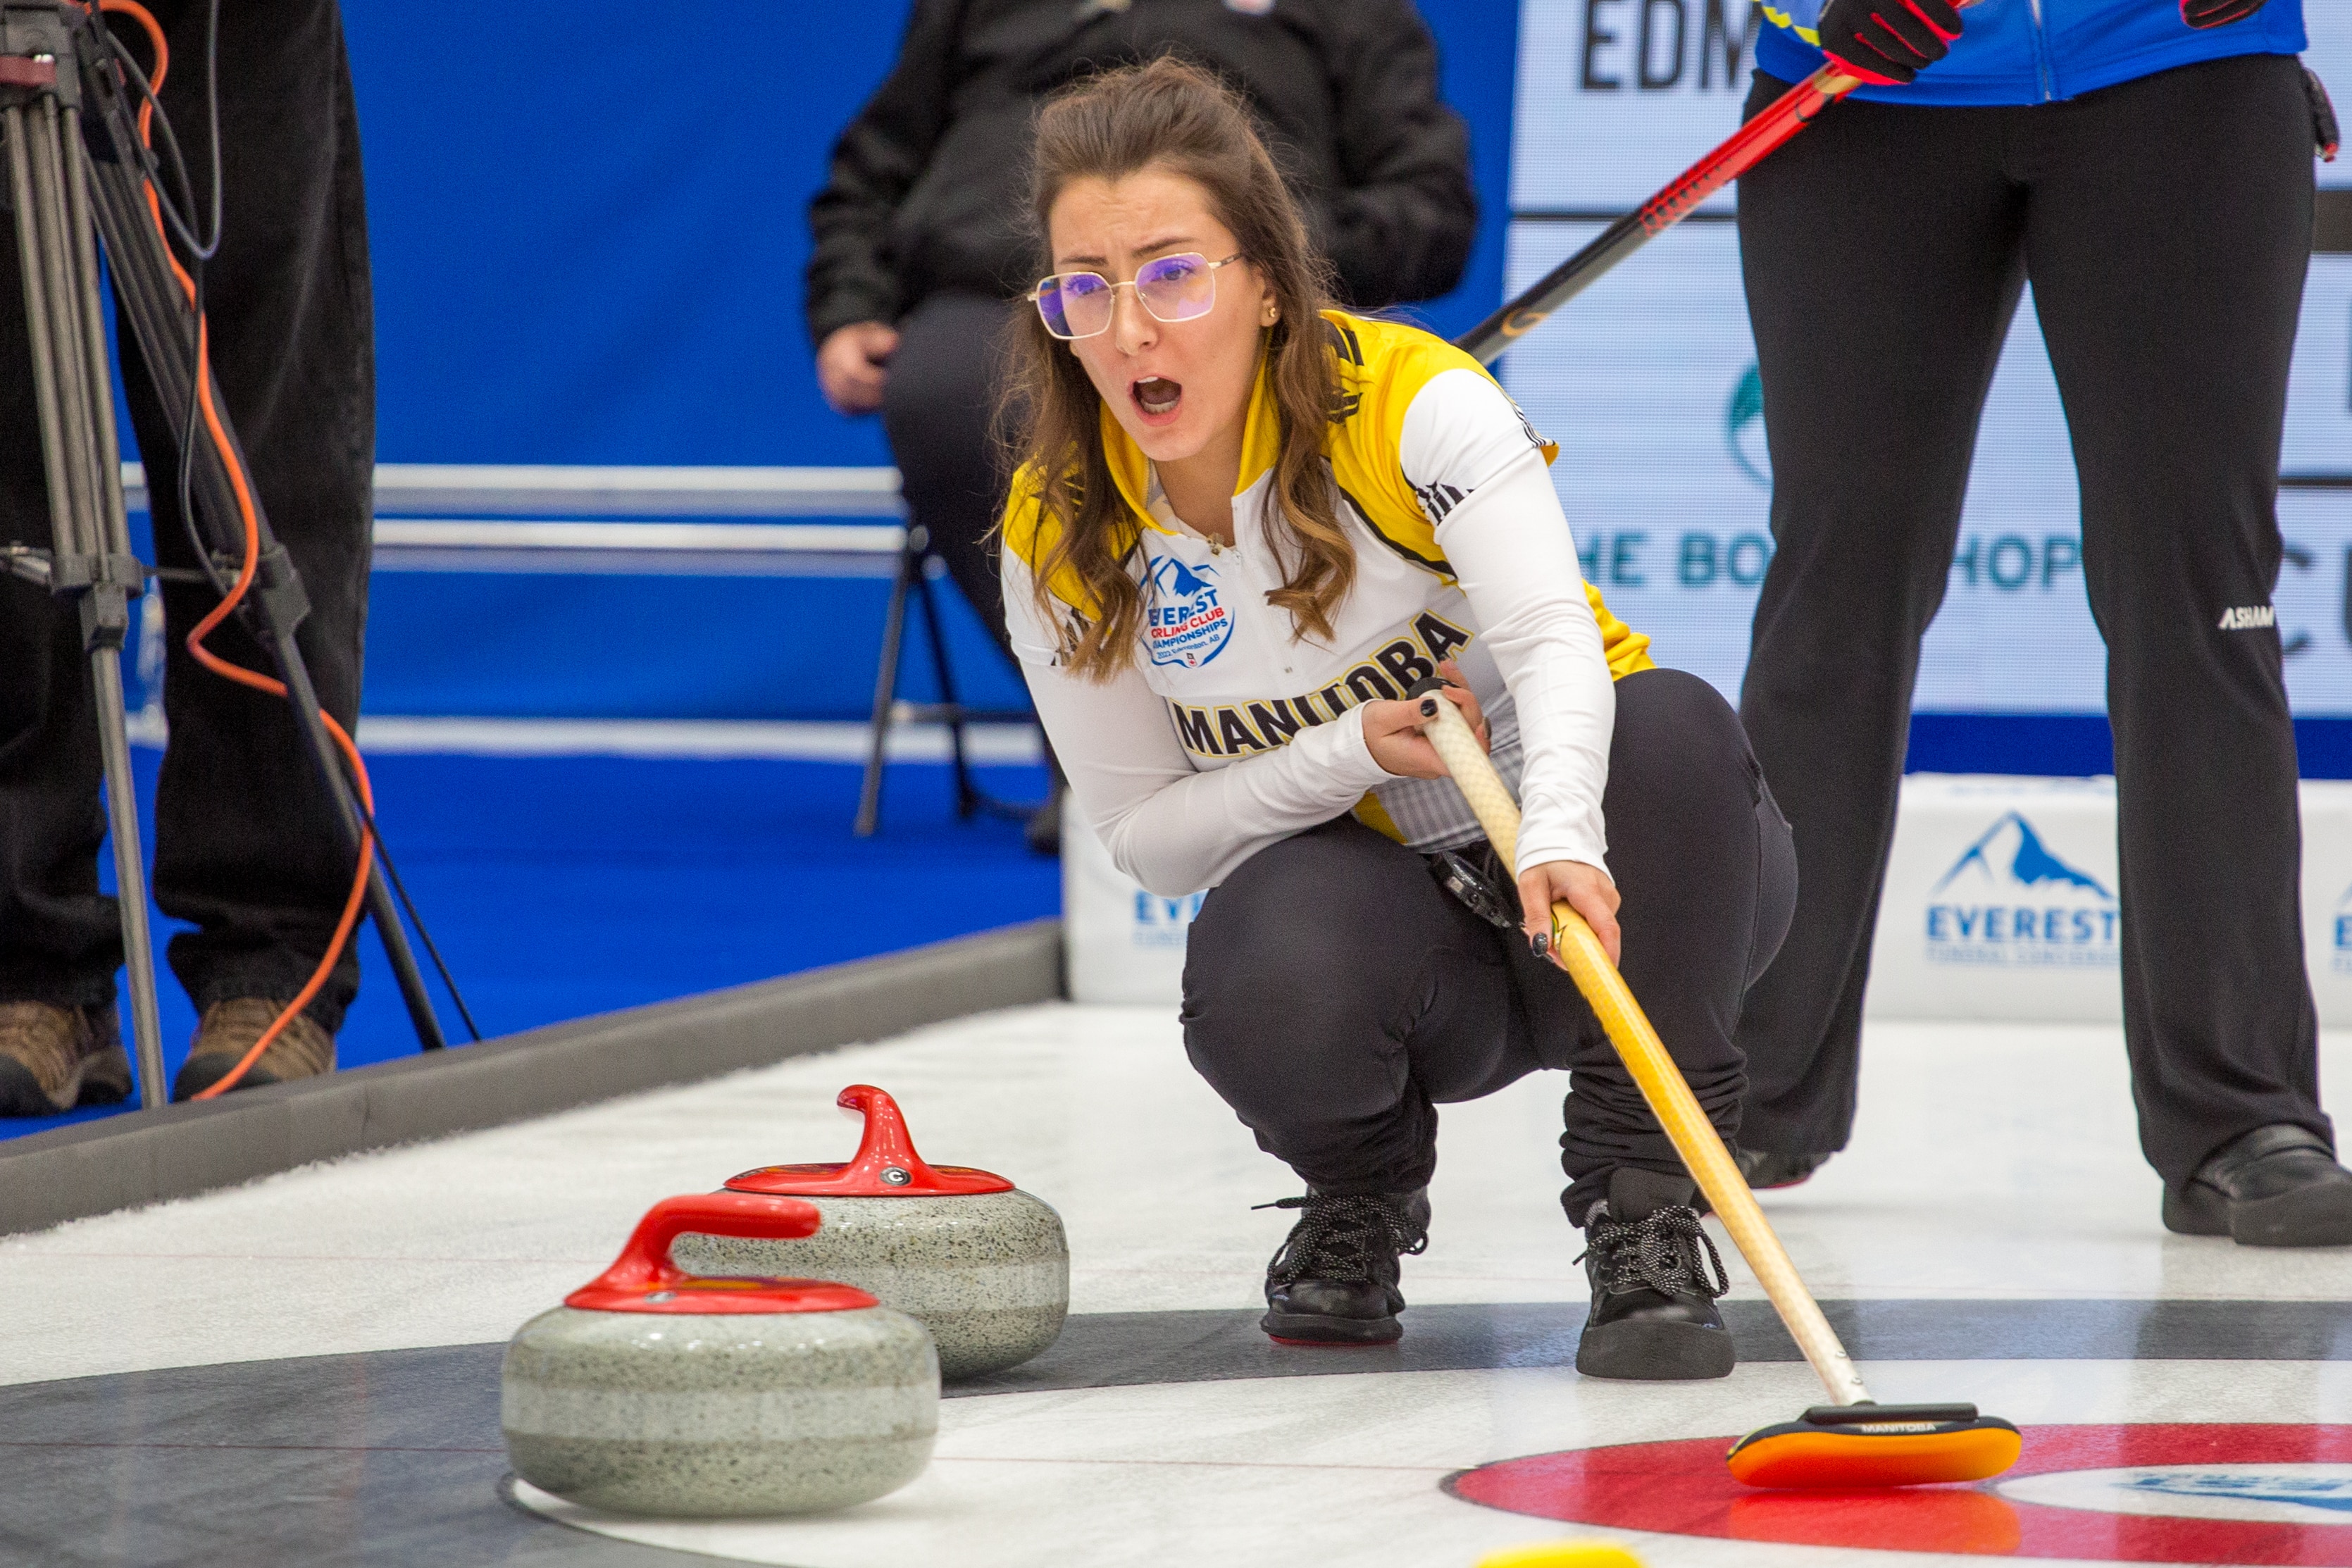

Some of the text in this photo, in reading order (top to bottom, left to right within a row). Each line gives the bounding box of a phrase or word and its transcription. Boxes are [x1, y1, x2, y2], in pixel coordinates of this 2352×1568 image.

[1151, 607, 1224, 638] CRLING CLUB
[1153, 618, 1228, 649] AMPIONSHIPS
[1171, 610, 1472, 757] MANITOBA
[1927, 905, 2120, 943] EVEREST
[1860, 1423, 1938, 1433] MANITOBA
